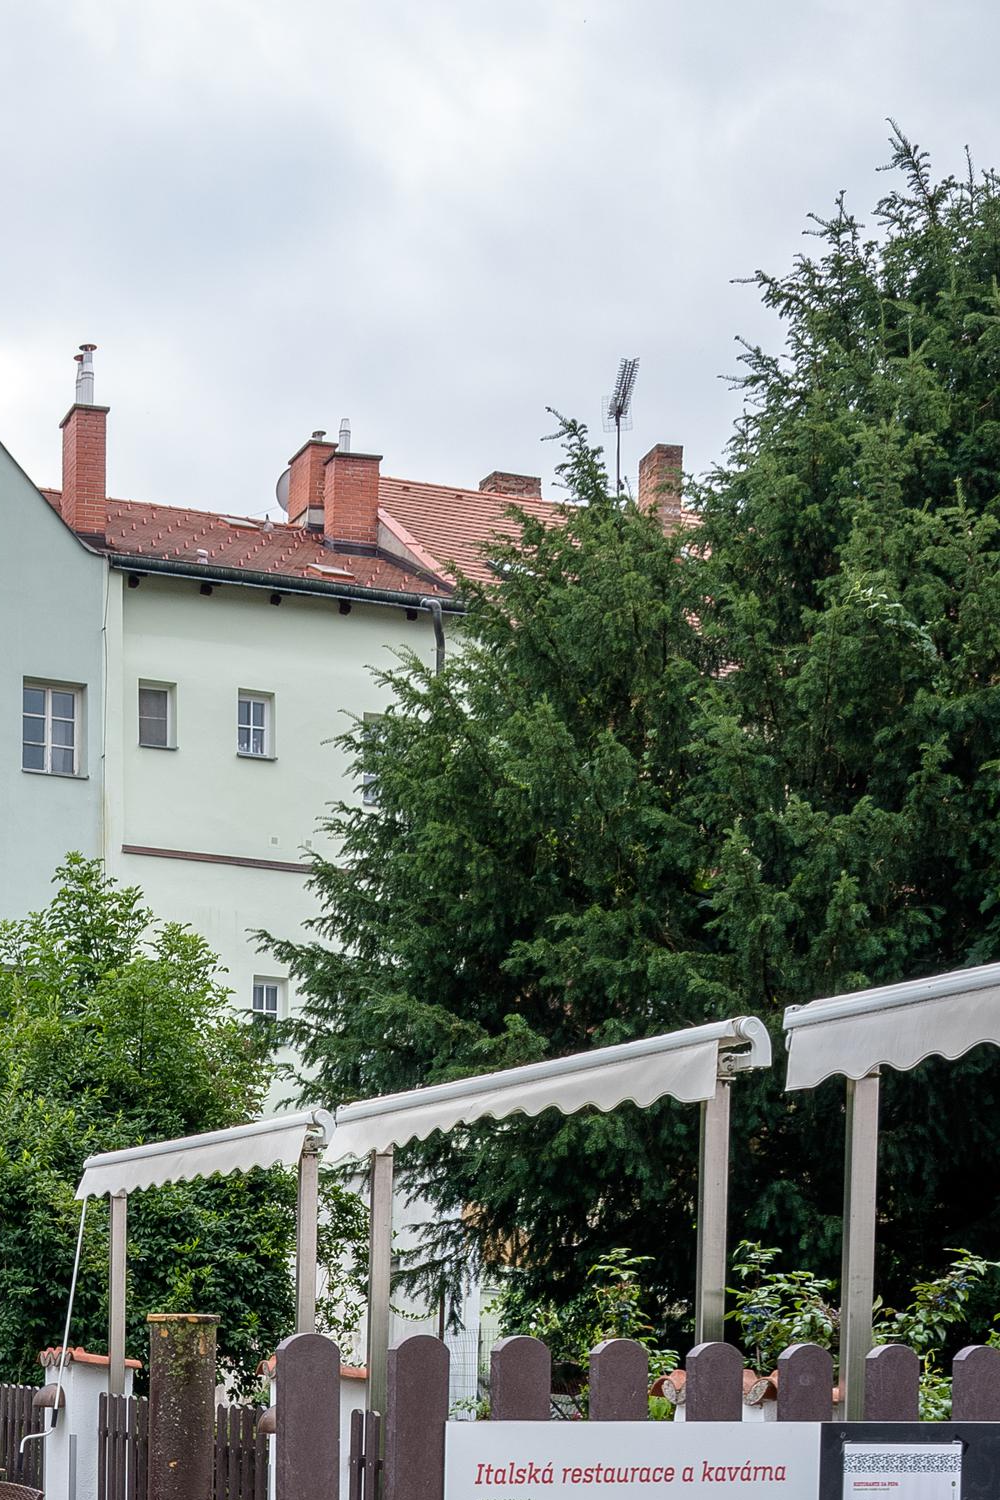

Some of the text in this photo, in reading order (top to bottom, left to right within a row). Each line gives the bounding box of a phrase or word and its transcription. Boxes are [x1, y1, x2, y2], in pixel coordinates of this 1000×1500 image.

[474, 1460, 787, 1485] Italská restaurace a kavárna
